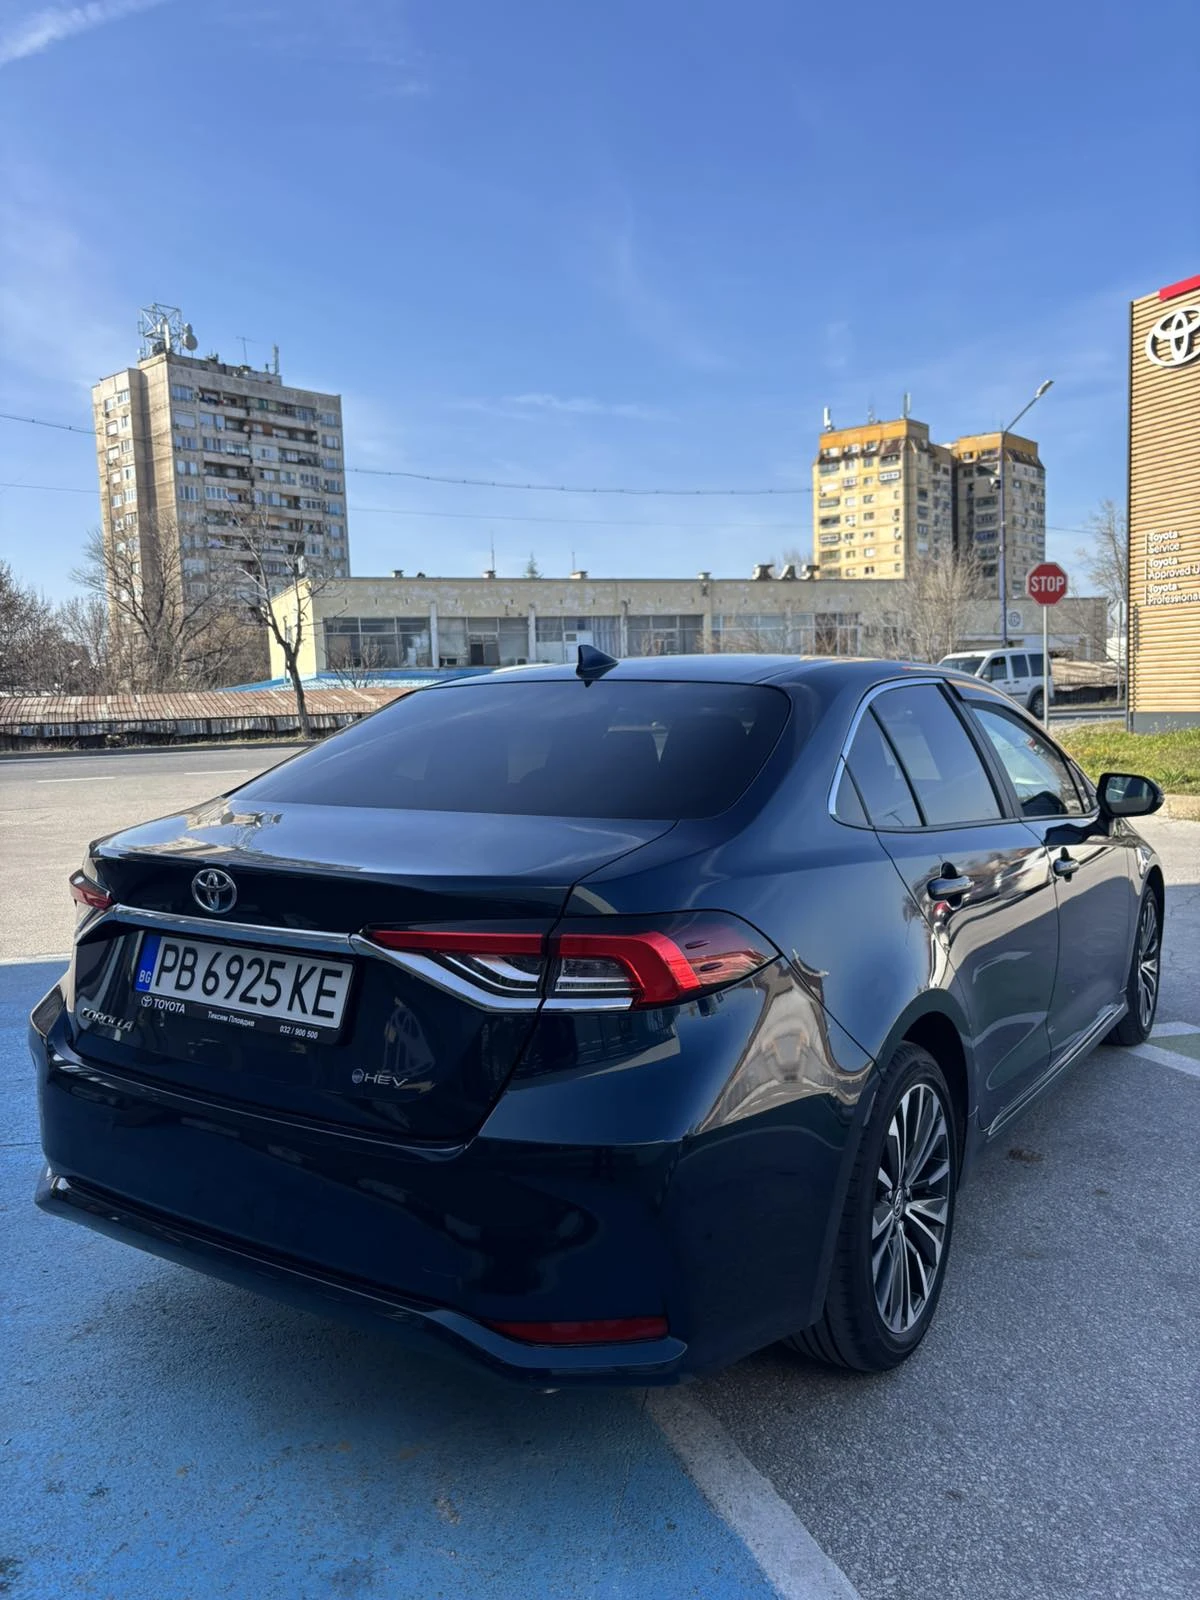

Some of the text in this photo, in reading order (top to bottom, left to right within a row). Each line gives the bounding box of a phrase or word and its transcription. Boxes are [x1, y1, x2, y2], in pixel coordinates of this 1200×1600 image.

[1149, 531, 1179, 543] Toyota
[1148, 543, 1180, 554] Service
[1149, 557, 1178, 569] Toyota
[1148, 565, 1191, 580] Approved
[1031, 575, 1065, 592] STOP
[1149, 583, 1178, 595] Toyota
[139, 969, 152, 984] BG
[153, 998, 186, 1014] TOYOTA
[81, 1007, 135, 1032] COROLLA
[280, 1025, 291, 1034] 032
[306, 1030, 319, 1040] 500
[364, 1072, 408, 1087] HEV
